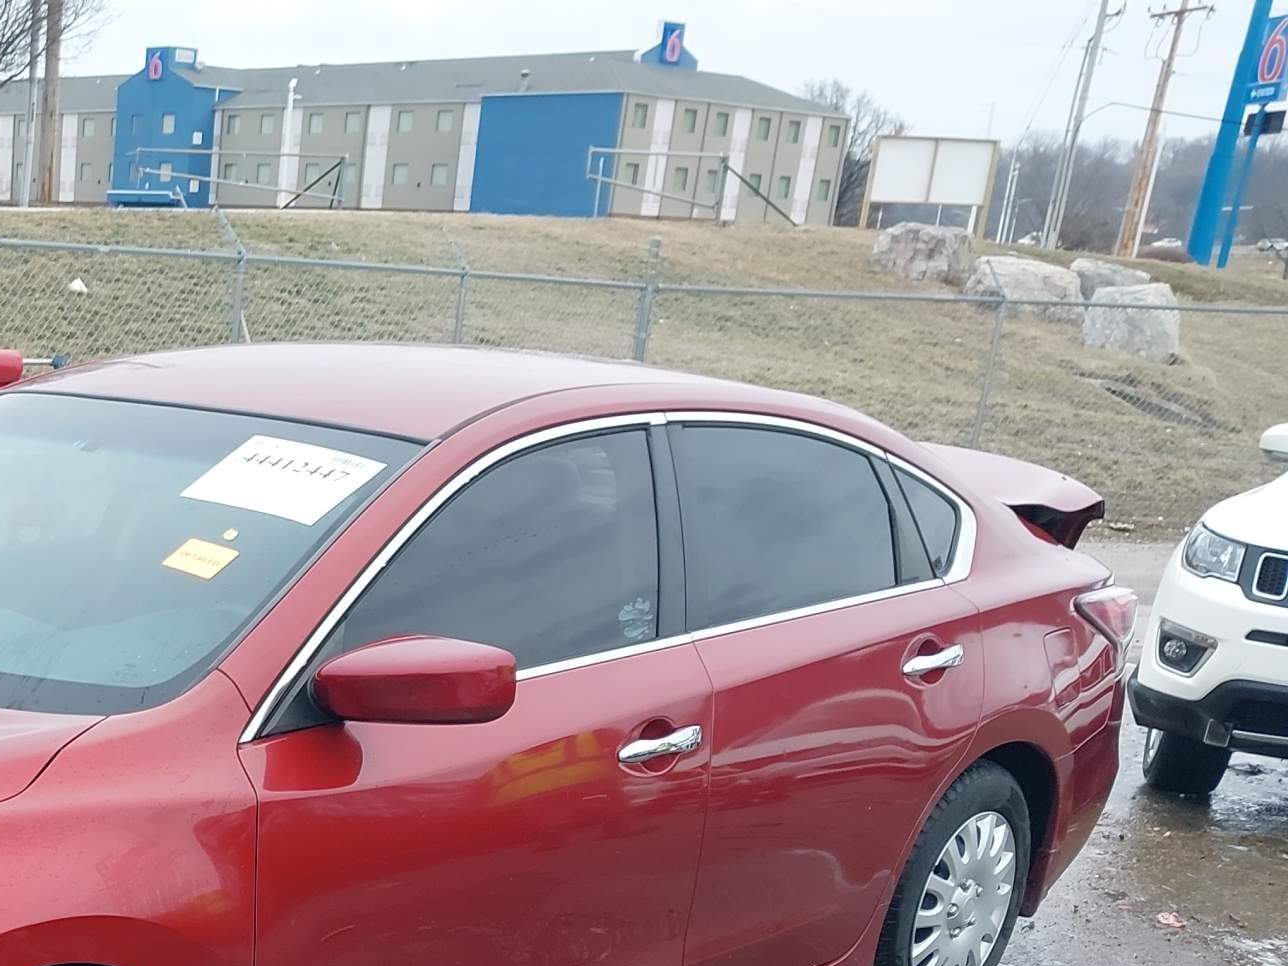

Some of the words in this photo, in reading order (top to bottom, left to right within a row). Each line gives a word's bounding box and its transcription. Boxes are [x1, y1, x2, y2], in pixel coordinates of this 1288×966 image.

[666, 29, 681, 63] 6
[1258, 17, 1288, 83] 6
[149, 51, 162, 81] 6
[242, 452, 351, 481] 44412447
